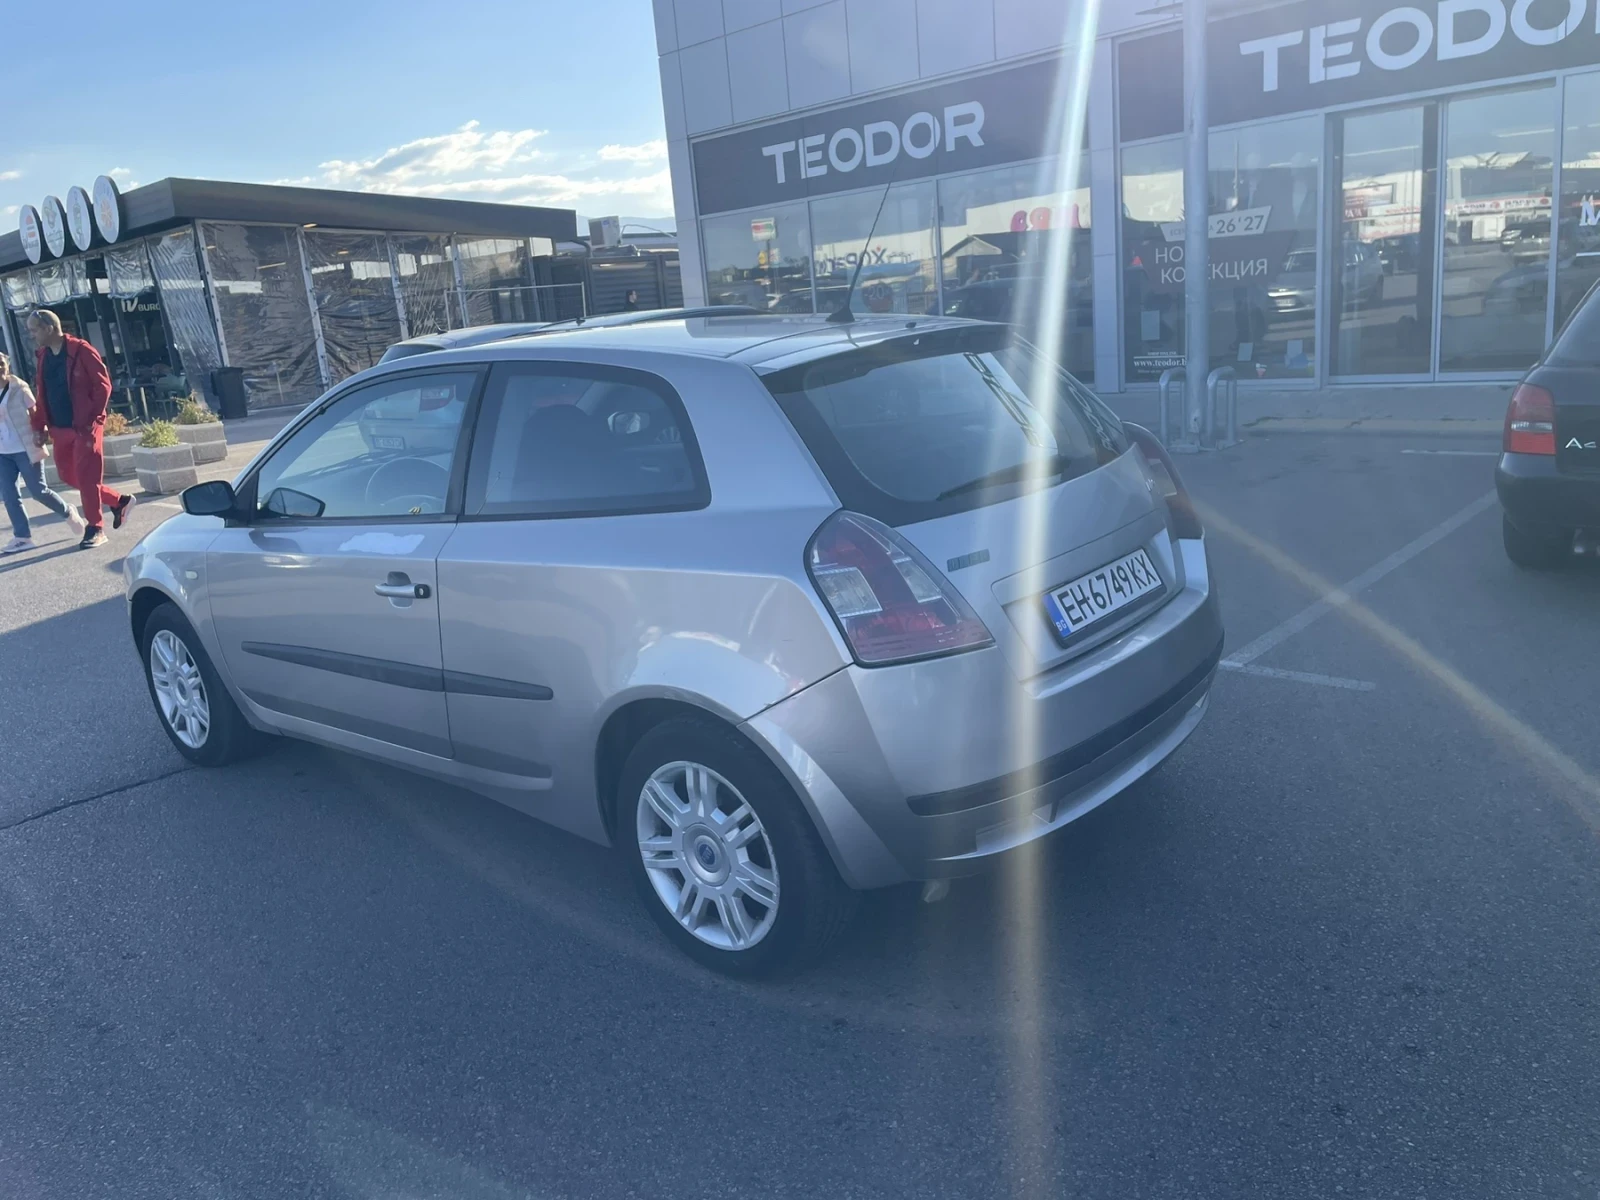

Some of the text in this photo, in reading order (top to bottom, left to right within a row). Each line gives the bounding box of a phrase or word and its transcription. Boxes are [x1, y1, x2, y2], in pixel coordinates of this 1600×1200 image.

[1239, 0, 1600, 92] TEODO
[762, 100, 985, 184] TEODOR
[1161, 258, 1268, 284] КОКЦИЯ
[1133, 358, 1187, 367] www.teodor.b
[1056, 619, 1068, 632] BG
